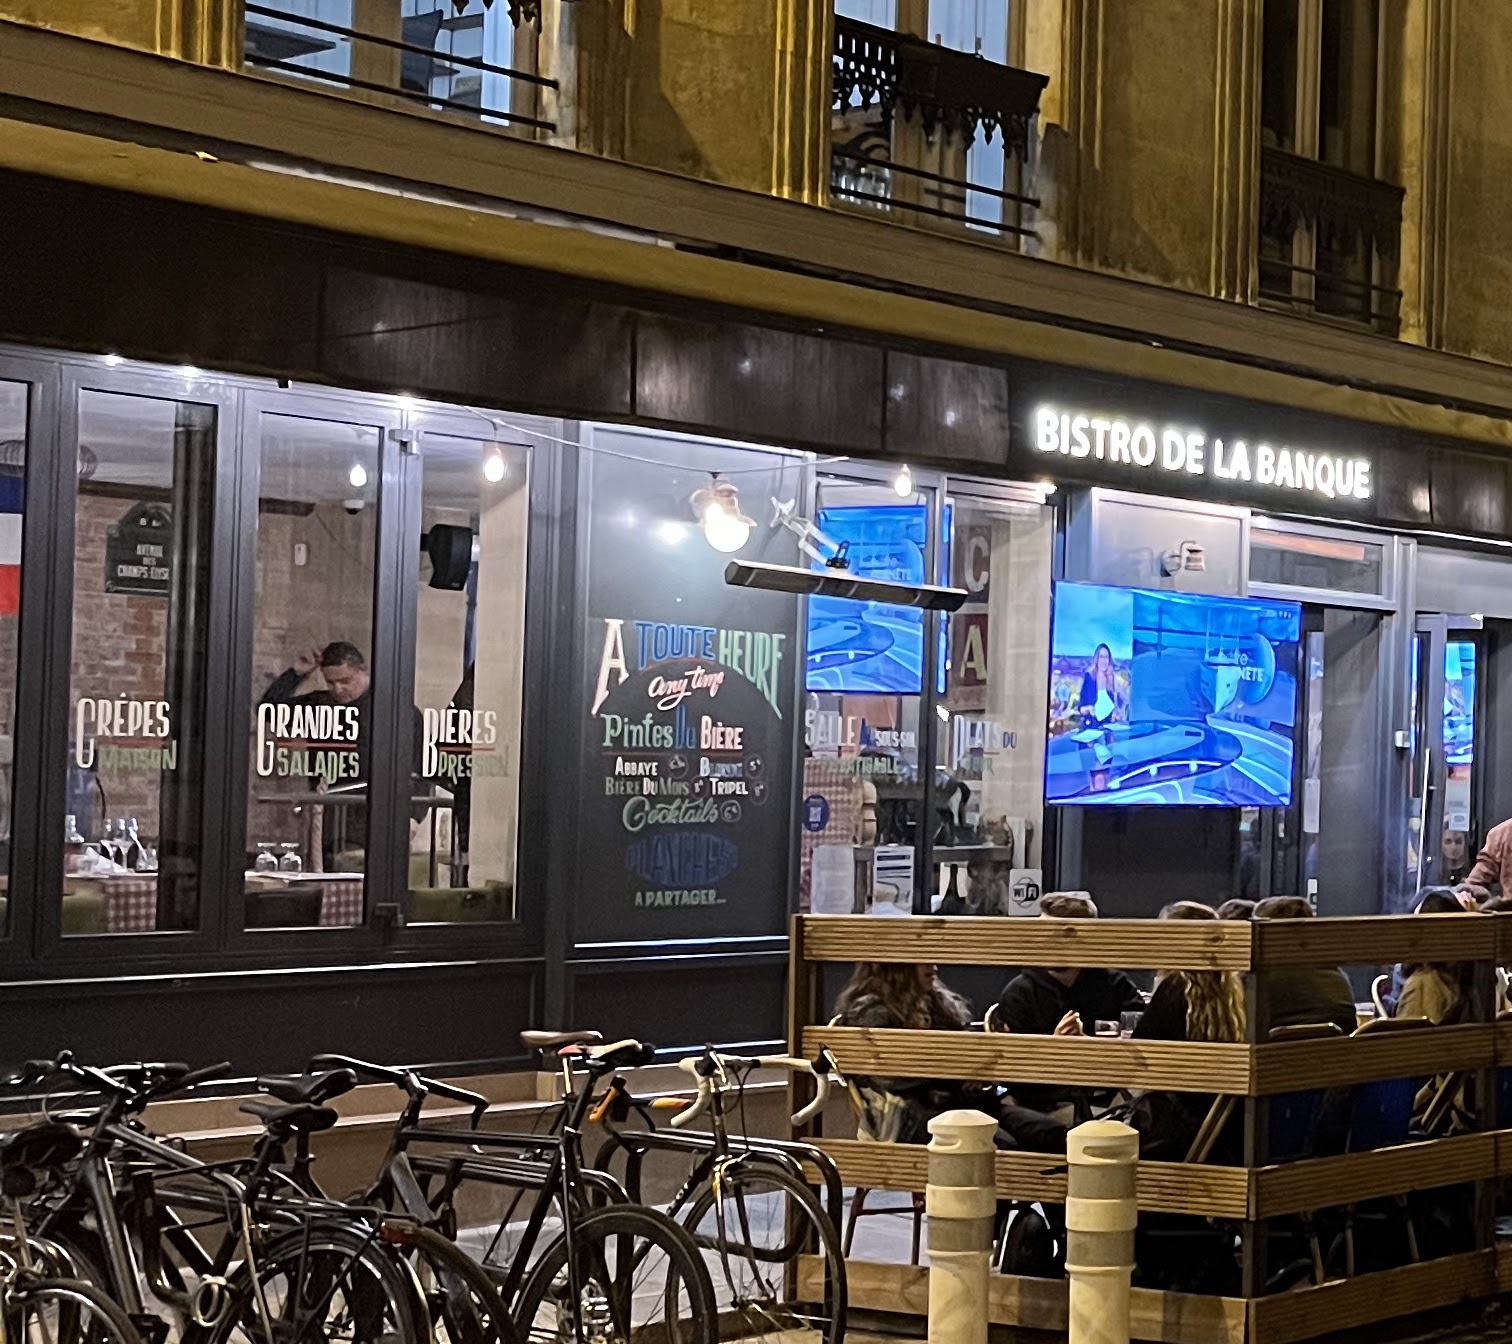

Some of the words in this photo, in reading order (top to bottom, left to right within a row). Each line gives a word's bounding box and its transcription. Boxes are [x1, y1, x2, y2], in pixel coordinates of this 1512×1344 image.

[1036, 407, 1156, 468] BISTRO
[1161, 428, 1205, 475] DE
[1213, 438, 1251, 482] LA
[1256, 444, 1374, 500] BANQUE
[591, 618, 630, 718] A
[634, 619, 717, 671] TOUTE
[719, 628, 786, 721] HEURE
[76, 692, 170, 768] CRÊPES
[256, 702, 360, 777] GRANDES
[276, 746, 360, 785] SALADES
[422, 700, 497, 778] BIÈRES
[600, 712, 673, 748] Pintes
[701, 715, 744, 750] BIÈRE
[952, 714, 1001, 771] PLATS
[1003, 731, 1018, 749] DU
[622, 795, 719, 832] Cocktails
